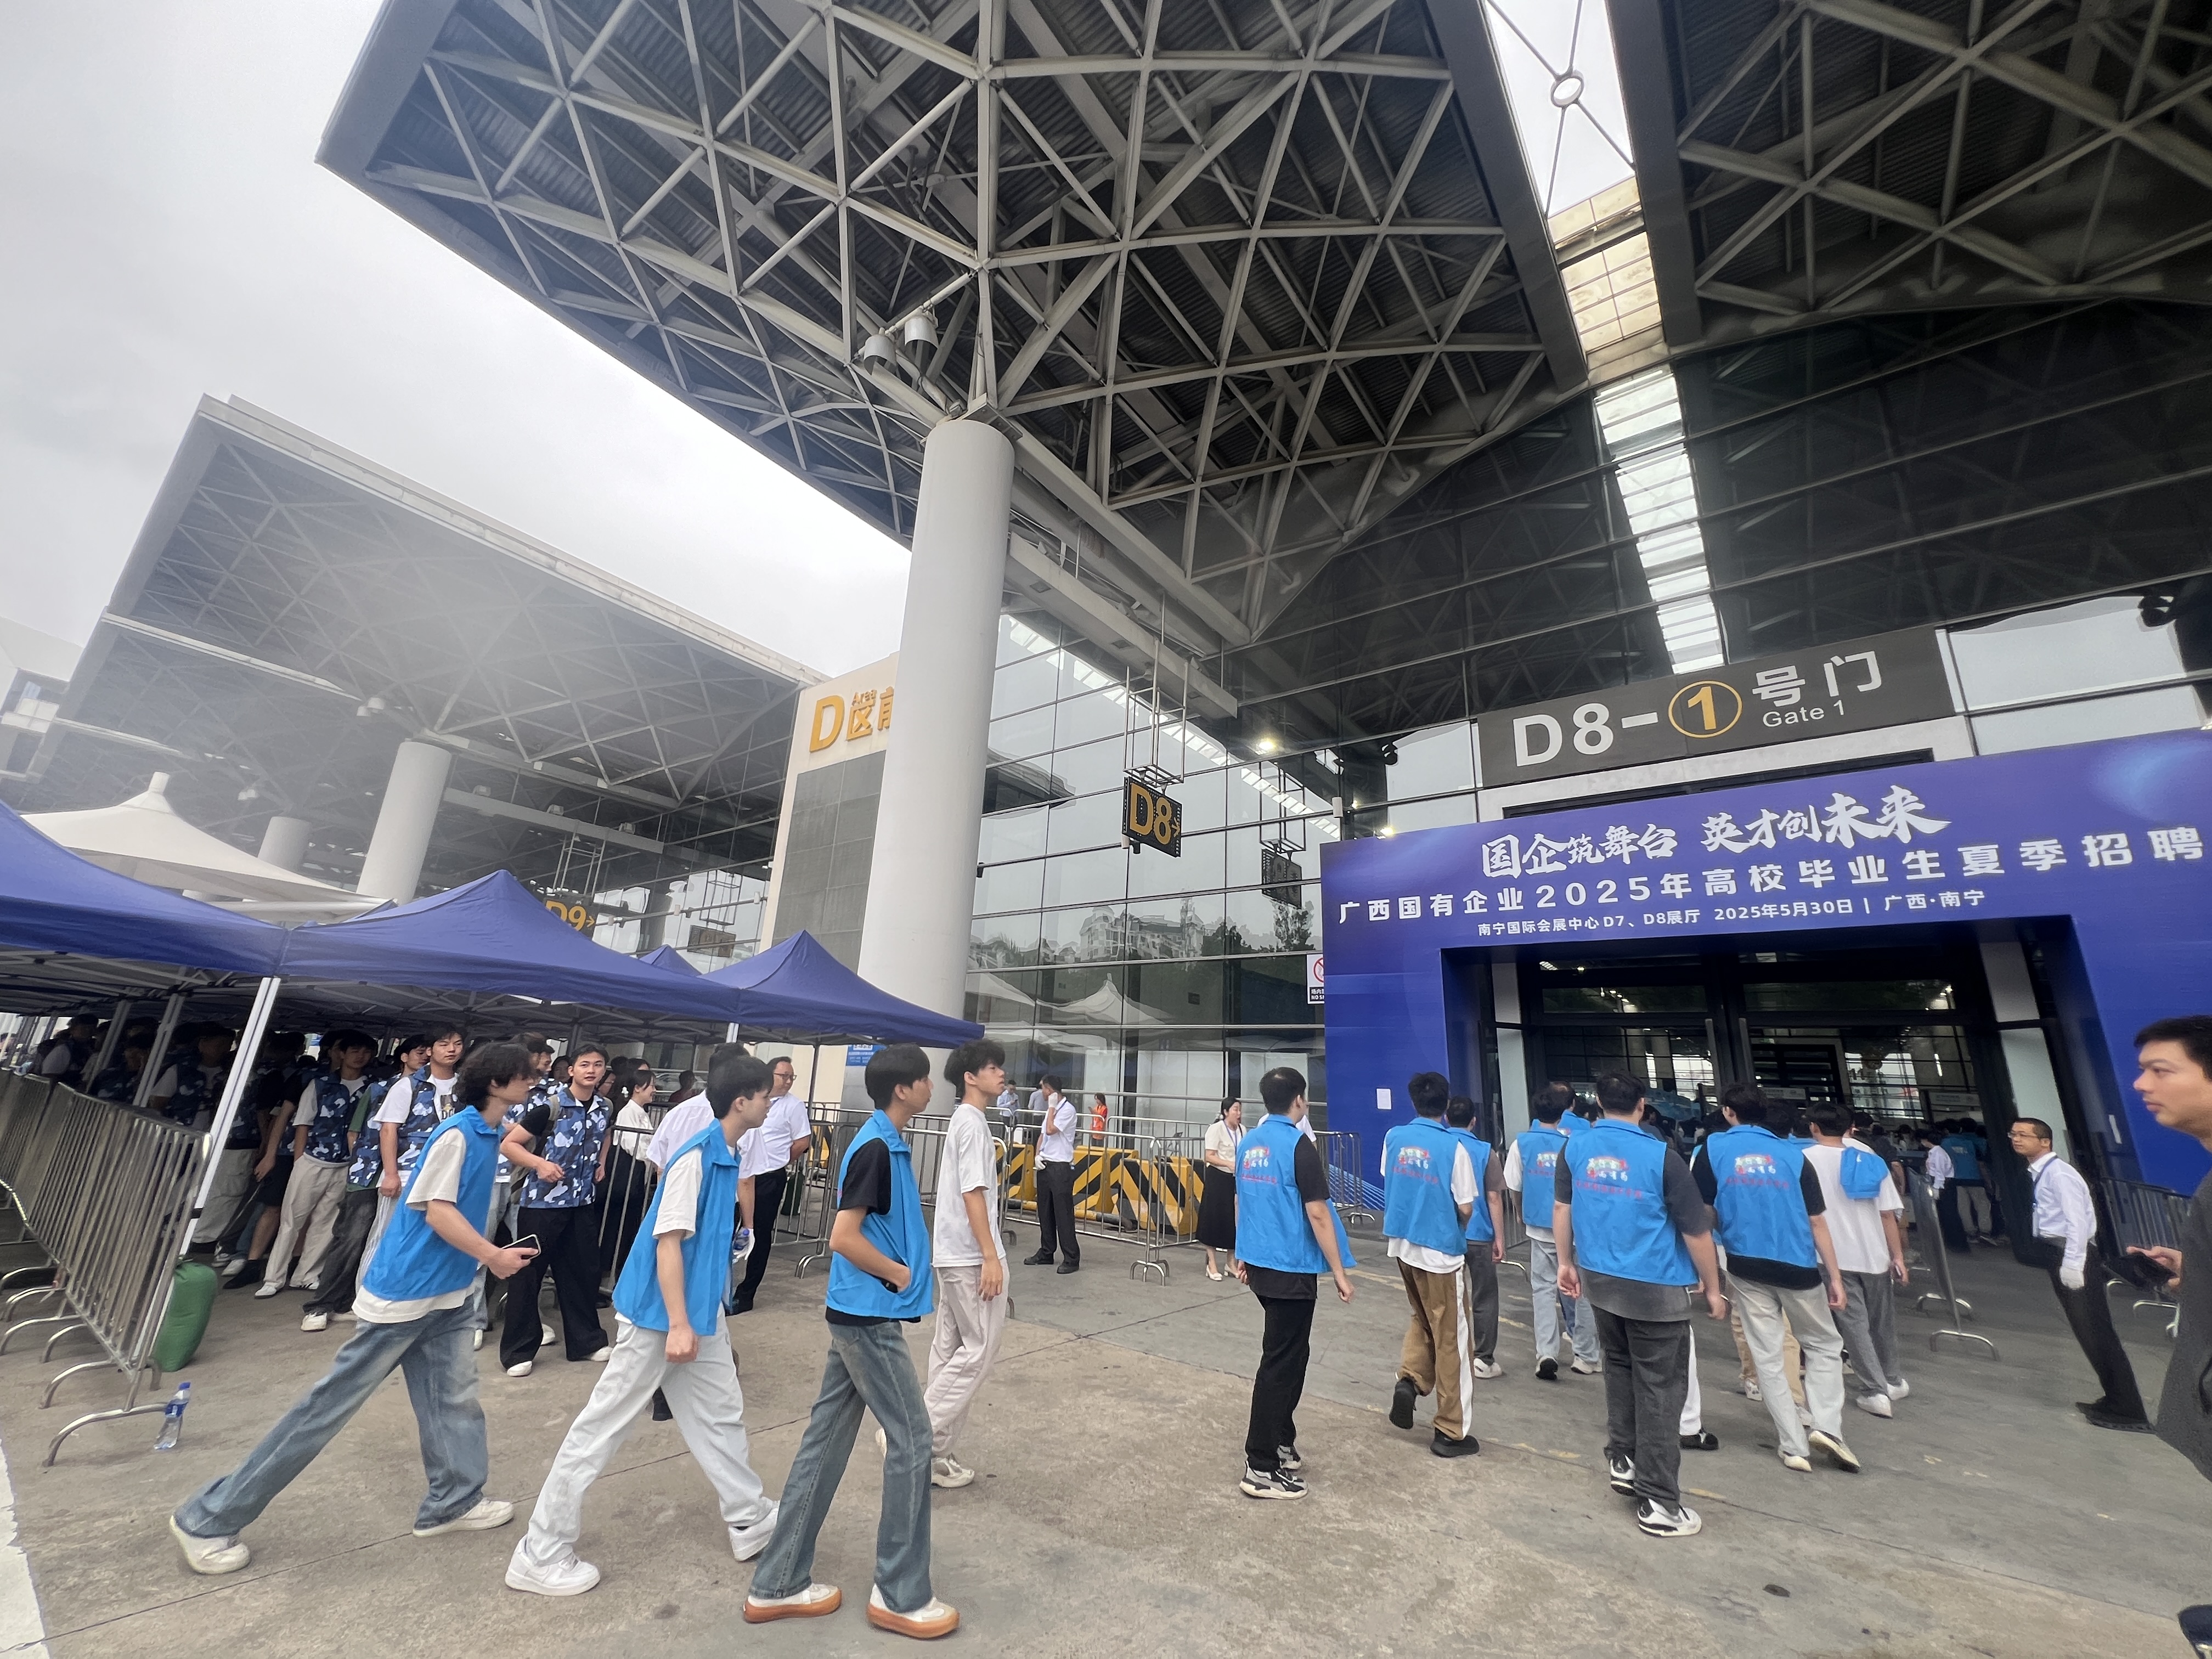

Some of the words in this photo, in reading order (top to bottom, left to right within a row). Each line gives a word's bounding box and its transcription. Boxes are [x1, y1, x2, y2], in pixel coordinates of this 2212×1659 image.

[851, 690, 877, 706] Area
[1763, 704, 1825, 728] Gate
[1833, 700, 1844, 716] 1
[1130, 783, 1172, 845] D8
[1482, 823, 1678, 879] 国企筑舞台
[1701, 785, 1952, 854] 英才创未来
[1339, 827, 2203, 924] 广西国有企业2025年高校毕业生夏季招聘
[1714, 899, 1853, 921] 2025年5月30日
